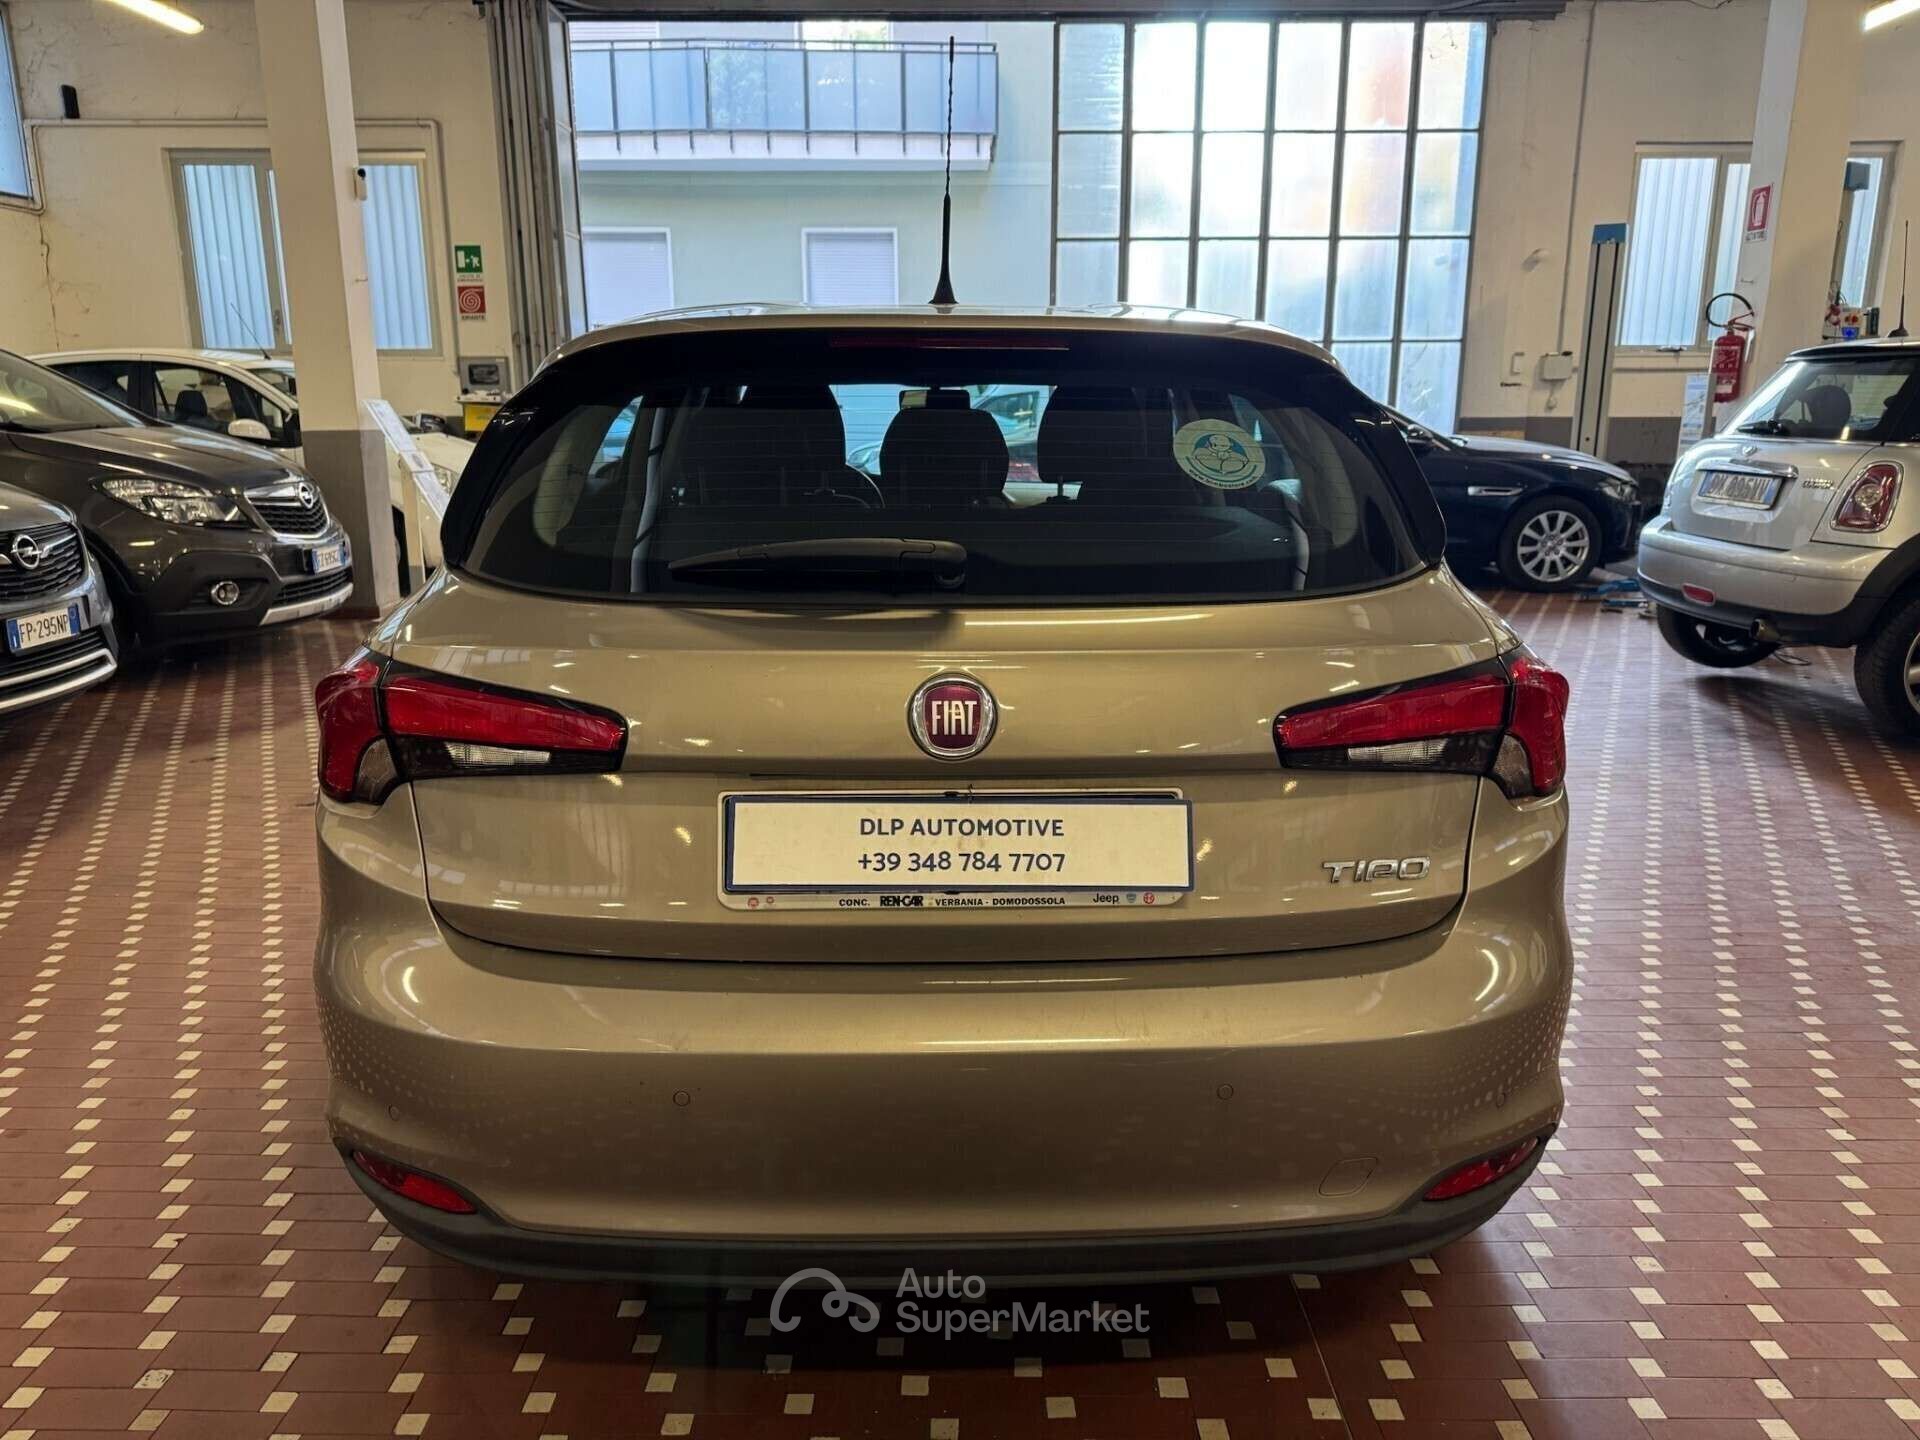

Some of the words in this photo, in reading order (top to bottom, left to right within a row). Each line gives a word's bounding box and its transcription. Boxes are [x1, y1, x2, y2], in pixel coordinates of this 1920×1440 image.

[931, 700, 977, 736] FIAT
[859, 818, 904, 836] DLP
[910, 818, 1065, 837] AUTOMOTIVE
[858, 852, 901, 872] +39
[907, 851, 952, 872] 348
[958, 851, 1002, 872] 784
[1008, 853, 1066, 872] 7707
[1323, 856, 1431, 883] TIPO
[839, 898, 871, 907] CONC.
[935, 898, 983, 906] VERBANIA
[992, 898, 1066, 906] DOMODOSSOLA
[1092, 893, 1119, 904] Jeep
